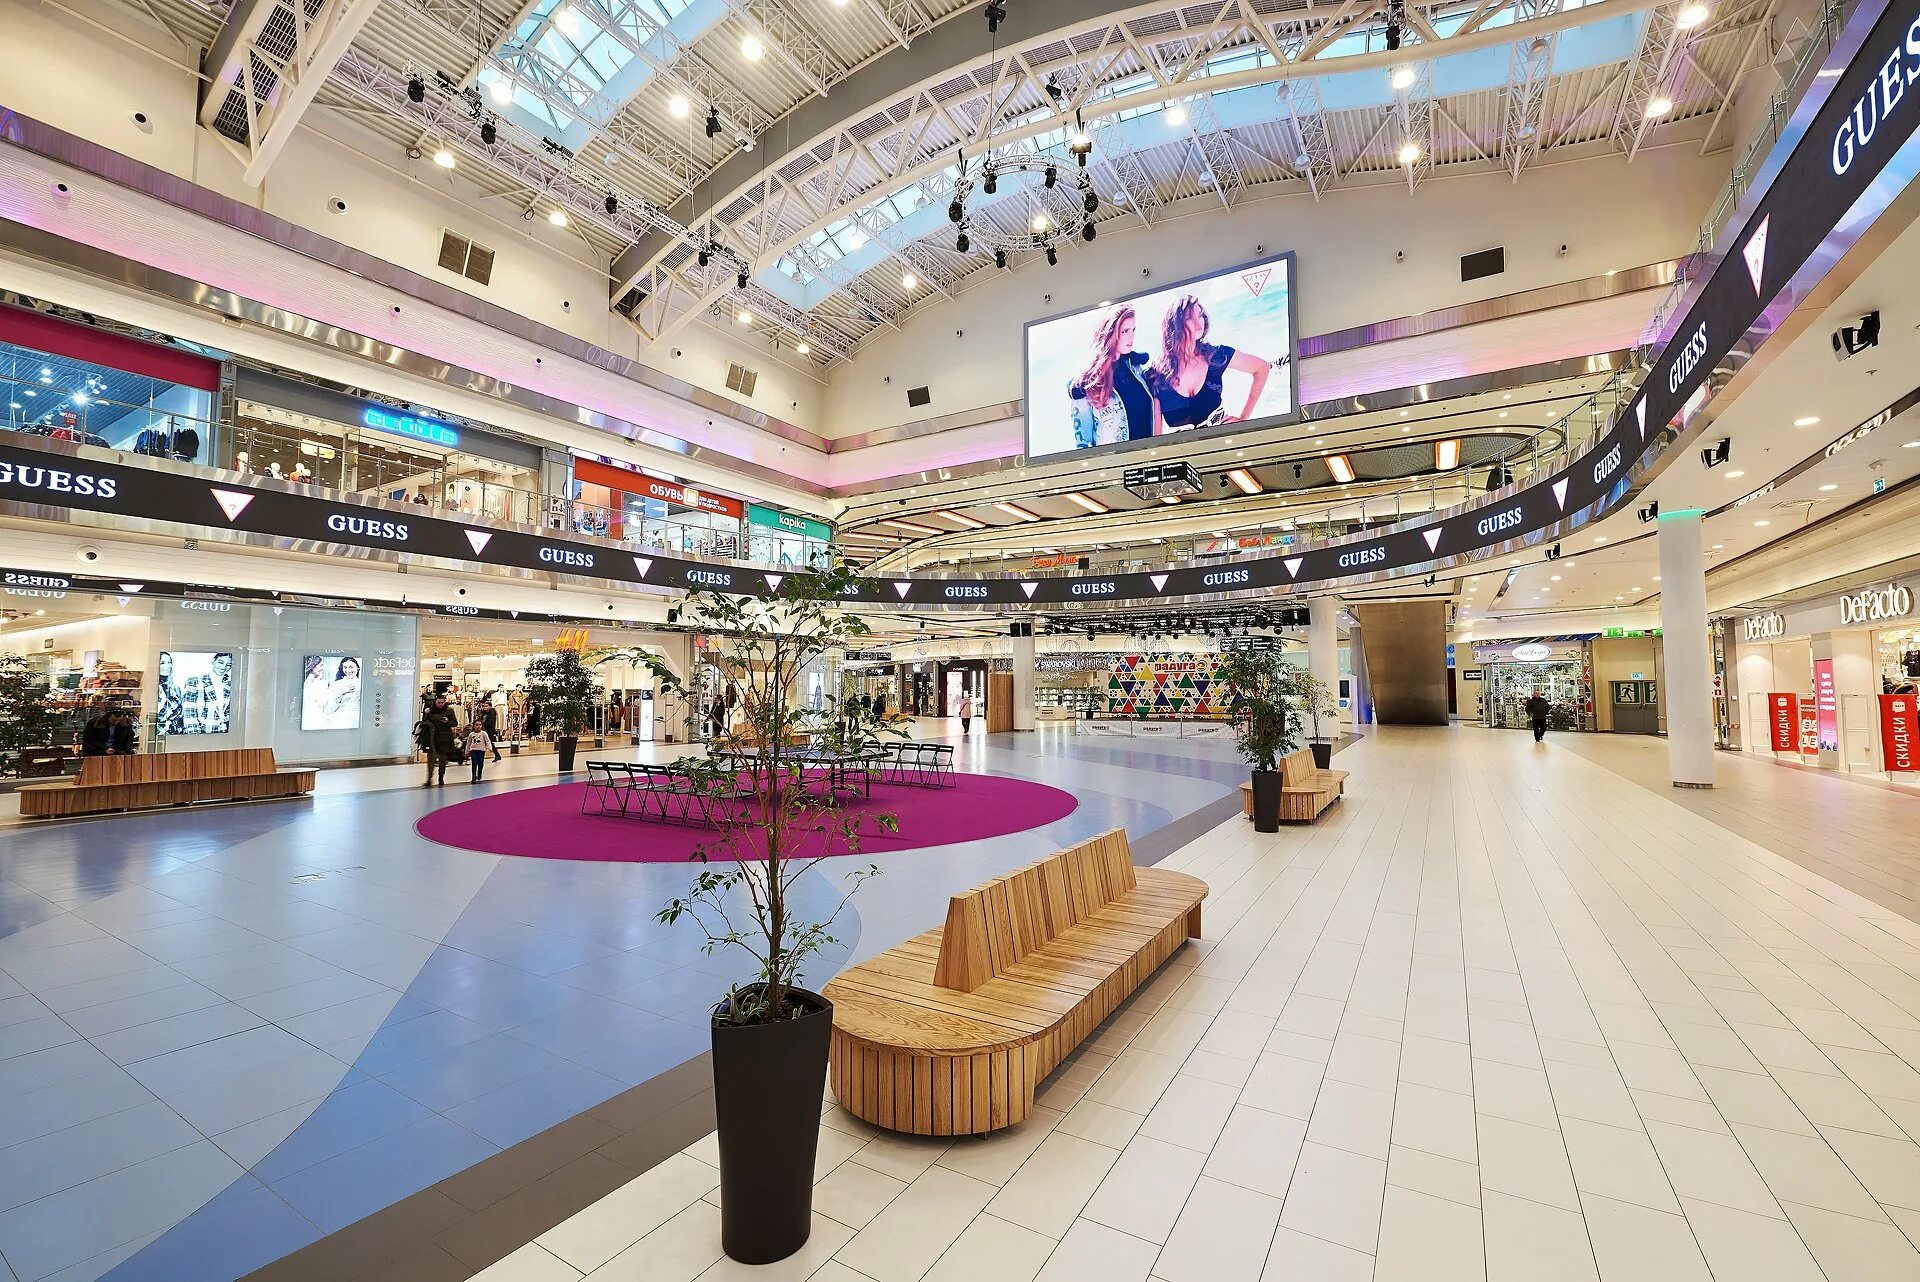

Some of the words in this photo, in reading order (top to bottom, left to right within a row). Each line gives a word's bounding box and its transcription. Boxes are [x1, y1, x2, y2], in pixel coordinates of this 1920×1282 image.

[1669, 321, 1707, 394] GUESS
[1594, 442, 1621, 484] GUESS
[650, 483, 684, 502] ОБУВЬ
[327, 514, 408, 541] GUESS
[779, 514, 806, 529] kapika
[1477, 506, 1522, 536] GUESS
[539, 546, 595, 569] GUESS
[1339, 546, 1386, 567] GUESS
[687, 569, 731, 586] GUESS
[1072, 581, 1116, 594] GUESS
[1204, 569, 1249, 586] GUESS
[944, 586, 987, 598] GUESS
[1839, 583, 1912, 625] DeFacto
[1743, 611, 1785, 640] DeFacto
[1154, 662, 1196, 671] радуга
[1777, 709, 1791, 748] СКИДКИ
[1892, 717, 1911, 768] СКИДКИ
